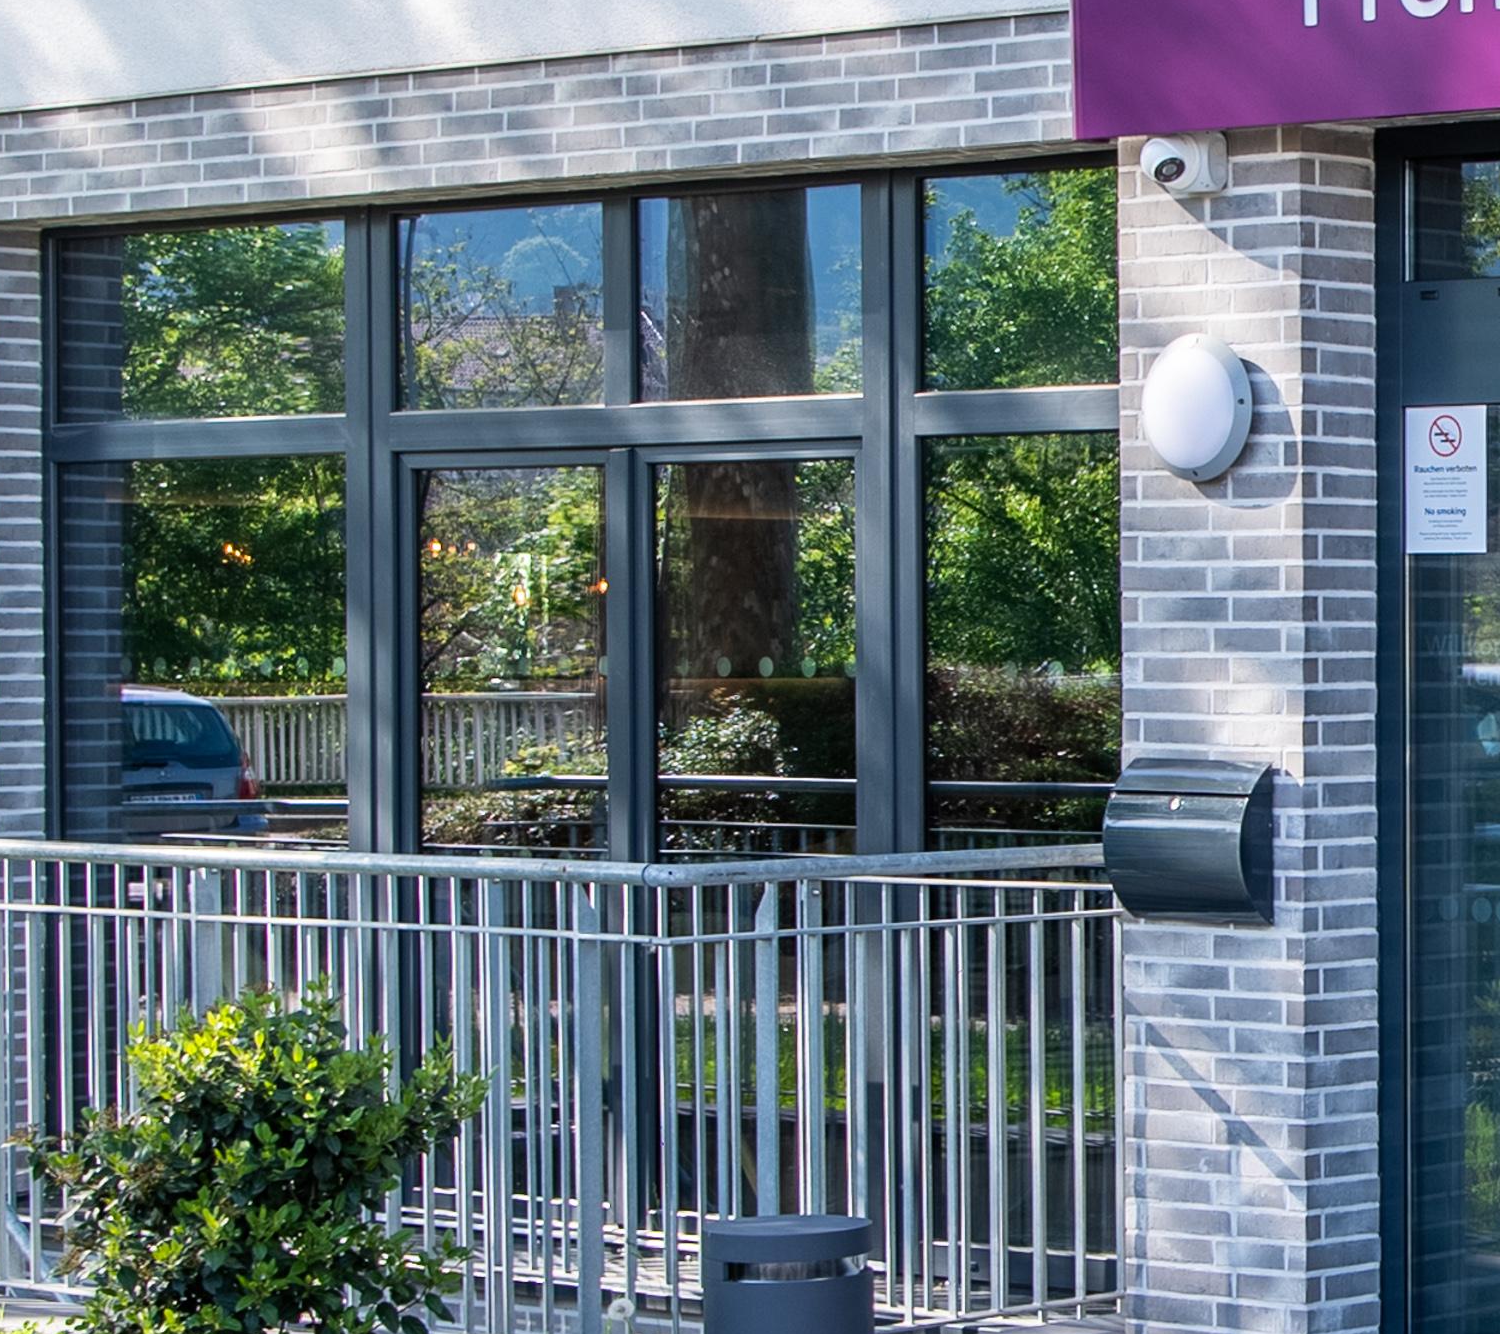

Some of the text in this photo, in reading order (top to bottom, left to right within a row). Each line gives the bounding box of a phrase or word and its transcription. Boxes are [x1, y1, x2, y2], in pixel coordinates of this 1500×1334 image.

[1413, 465, 1477, 473] Rauchen verboten
[1436, 508, 1467, 517] smoking
